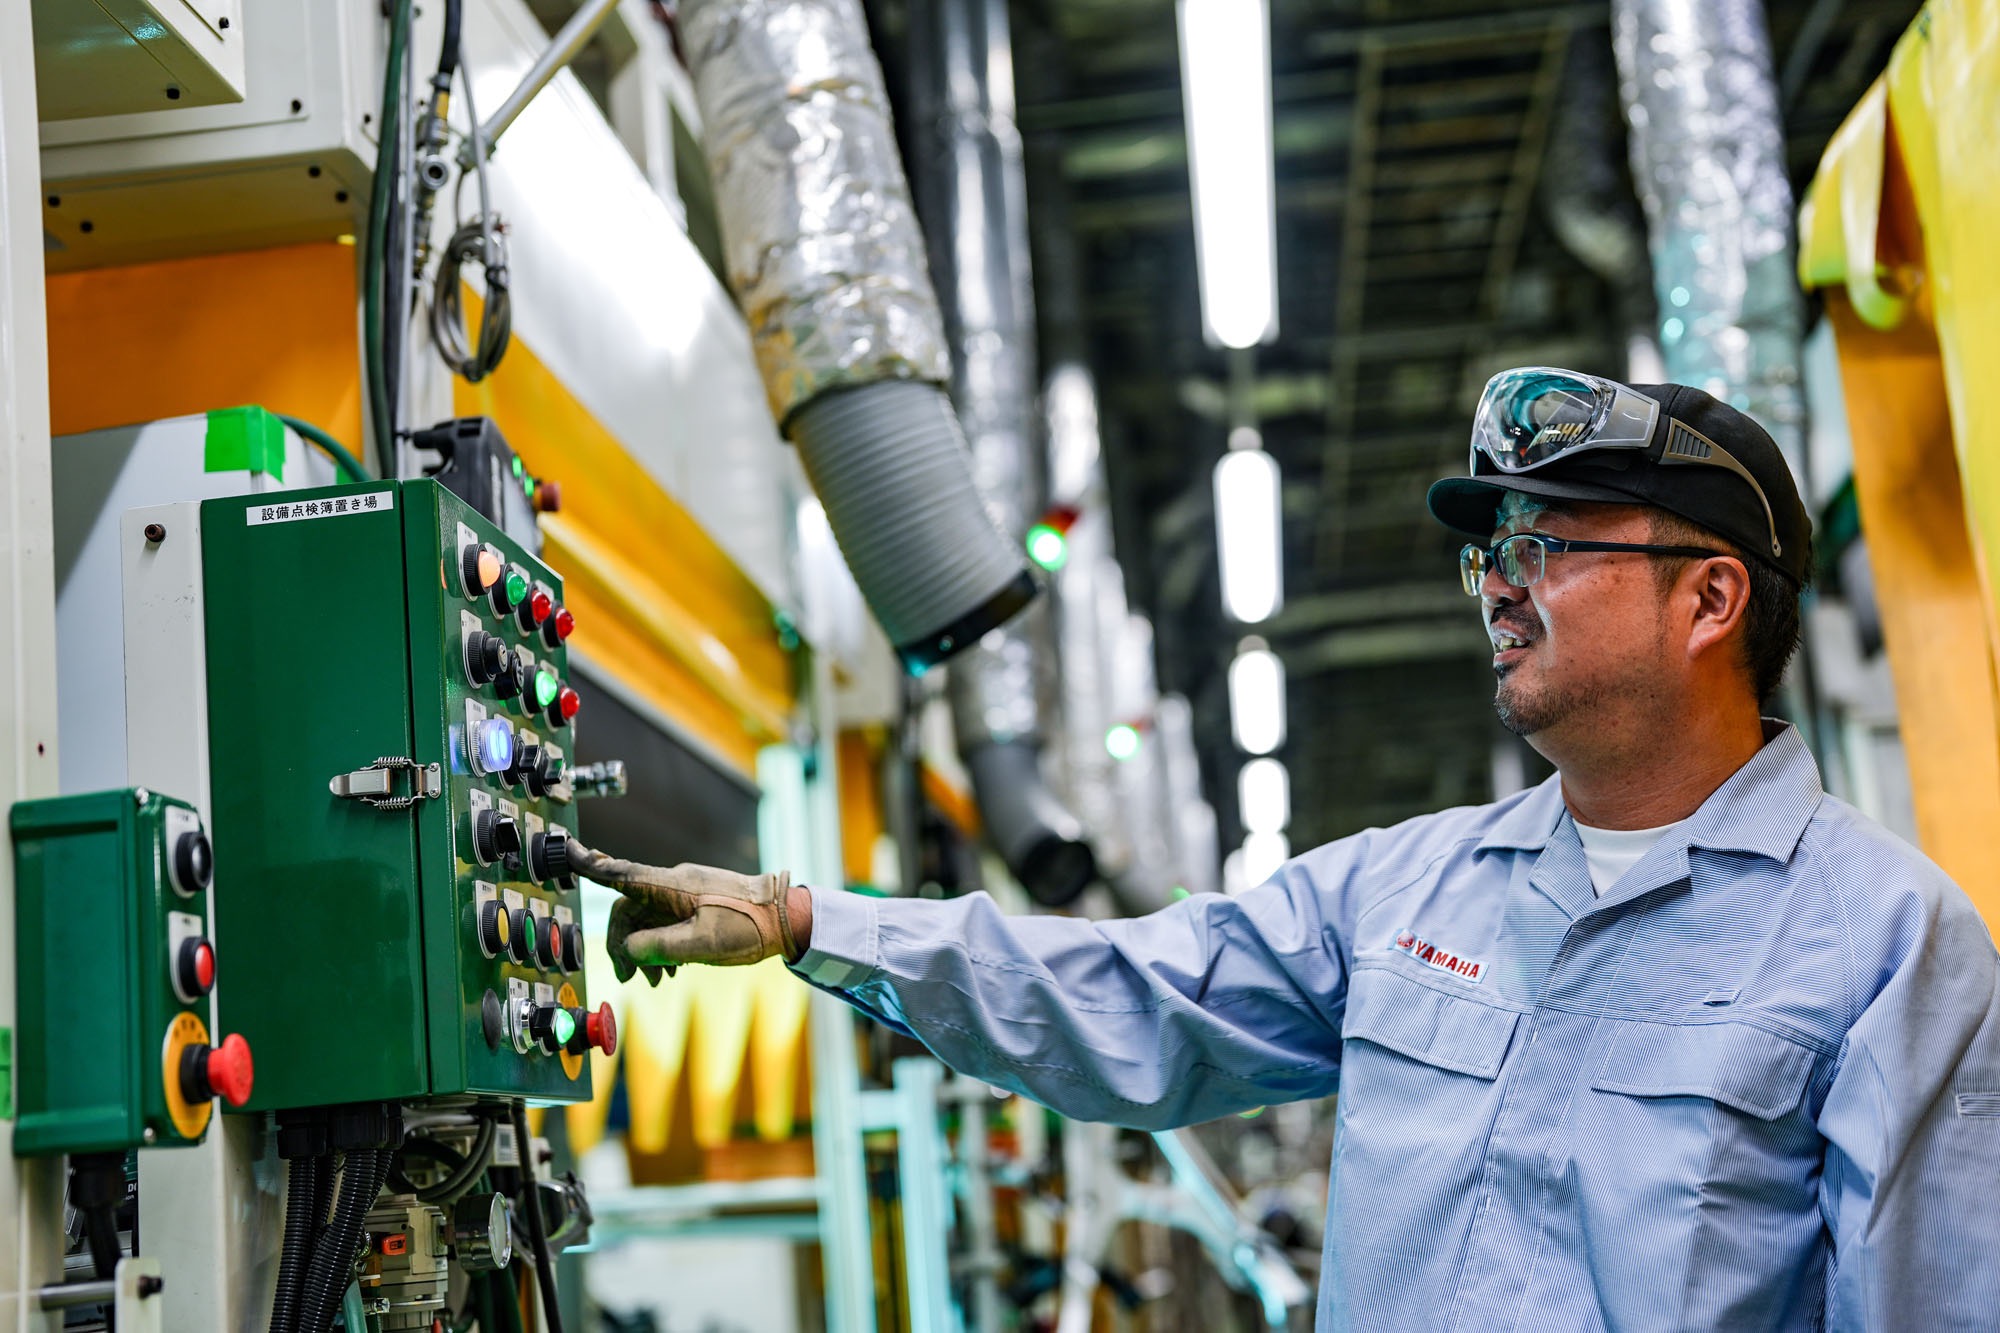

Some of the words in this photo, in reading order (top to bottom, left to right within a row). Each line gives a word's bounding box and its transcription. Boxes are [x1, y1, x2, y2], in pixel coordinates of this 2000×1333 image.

[261, 495, 377, 522] 設備点検簿置き場
[1415, 940, 1480, 978] YAMAHA
